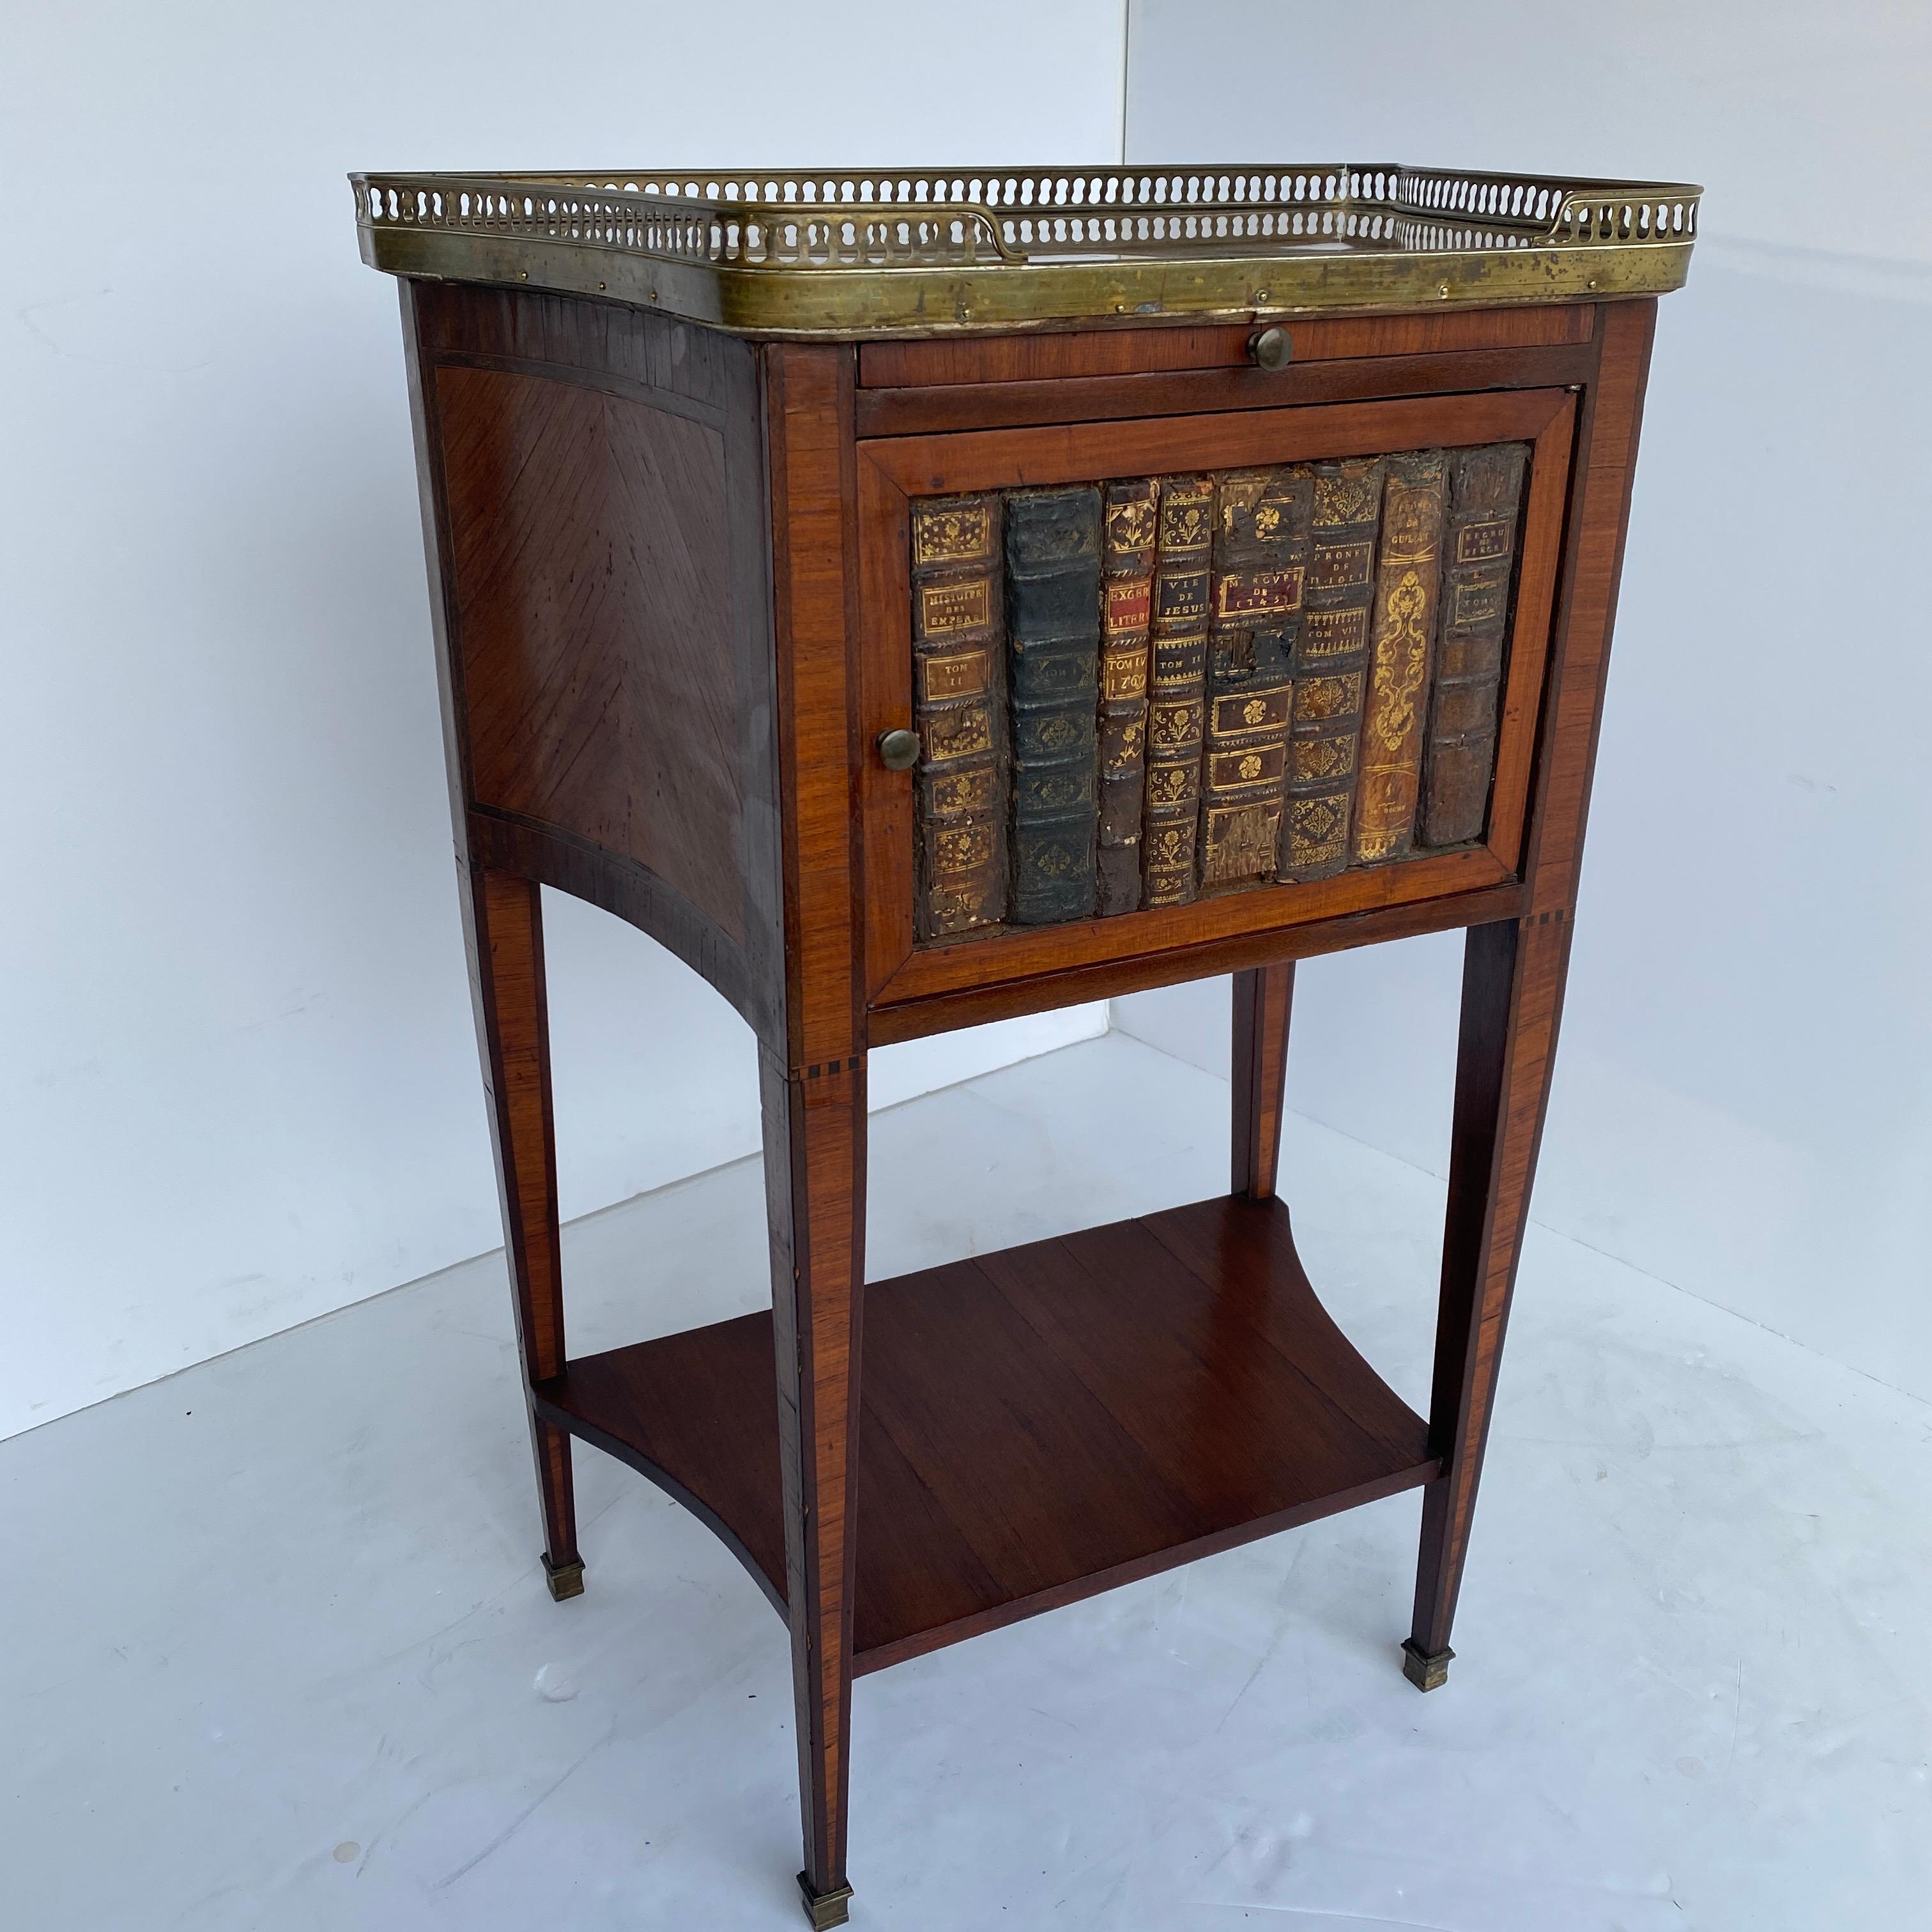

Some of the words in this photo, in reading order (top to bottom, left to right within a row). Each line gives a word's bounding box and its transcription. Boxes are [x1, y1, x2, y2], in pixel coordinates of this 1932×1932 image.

[1314, 548, 1368, 562] PRONES
[1333, 562, 1350, 571] DE
[1169, 578, 1200, 590] VIE
[930, 589, 983, 606] HISTOIRE
[1178, 592, 1193, 602] DE
[1253, 588, 1268, 596] DE
[945, 604, 965, 614] DES
[1164, 603, 1205, 616] JESUS
[1342, 626, 1357, 635] VII
[1108, 658, 1133, 670] TOM
[1135, 656, 1146, 666] IV
[1159, 659, 1183, 670] TOM
[1192, 655, 1202, 664] II
[945, 663, 968, 674] TOM
[950, 677, 962, 686] II
